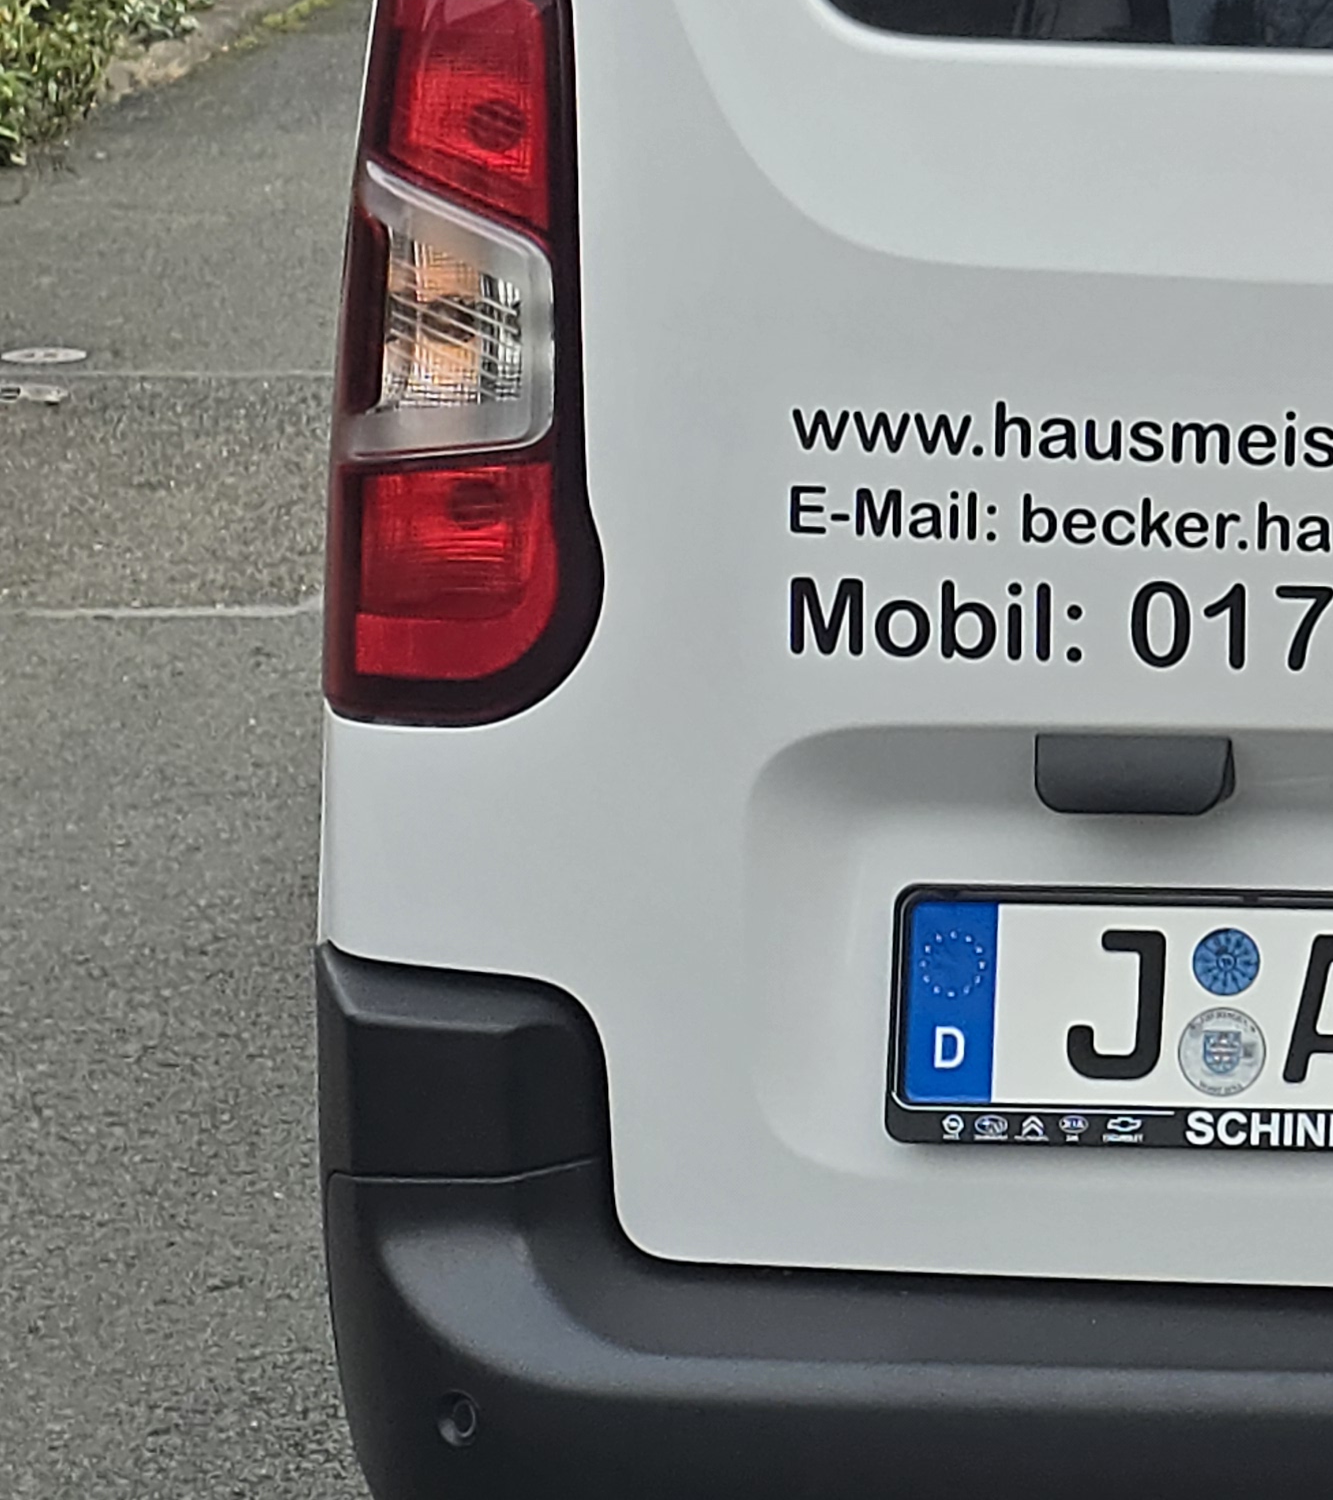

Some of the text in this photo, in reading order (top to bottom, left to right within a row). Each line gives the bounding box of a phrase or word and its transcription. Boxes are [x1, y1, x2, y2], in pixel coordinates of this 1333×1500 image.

[790, 485, 998, 542] E-Mail:
[790, 576, 1083, 663] Mobil:
[1066, 929, 1167, 1081] J
[934, 1026, 965, 1069] D
